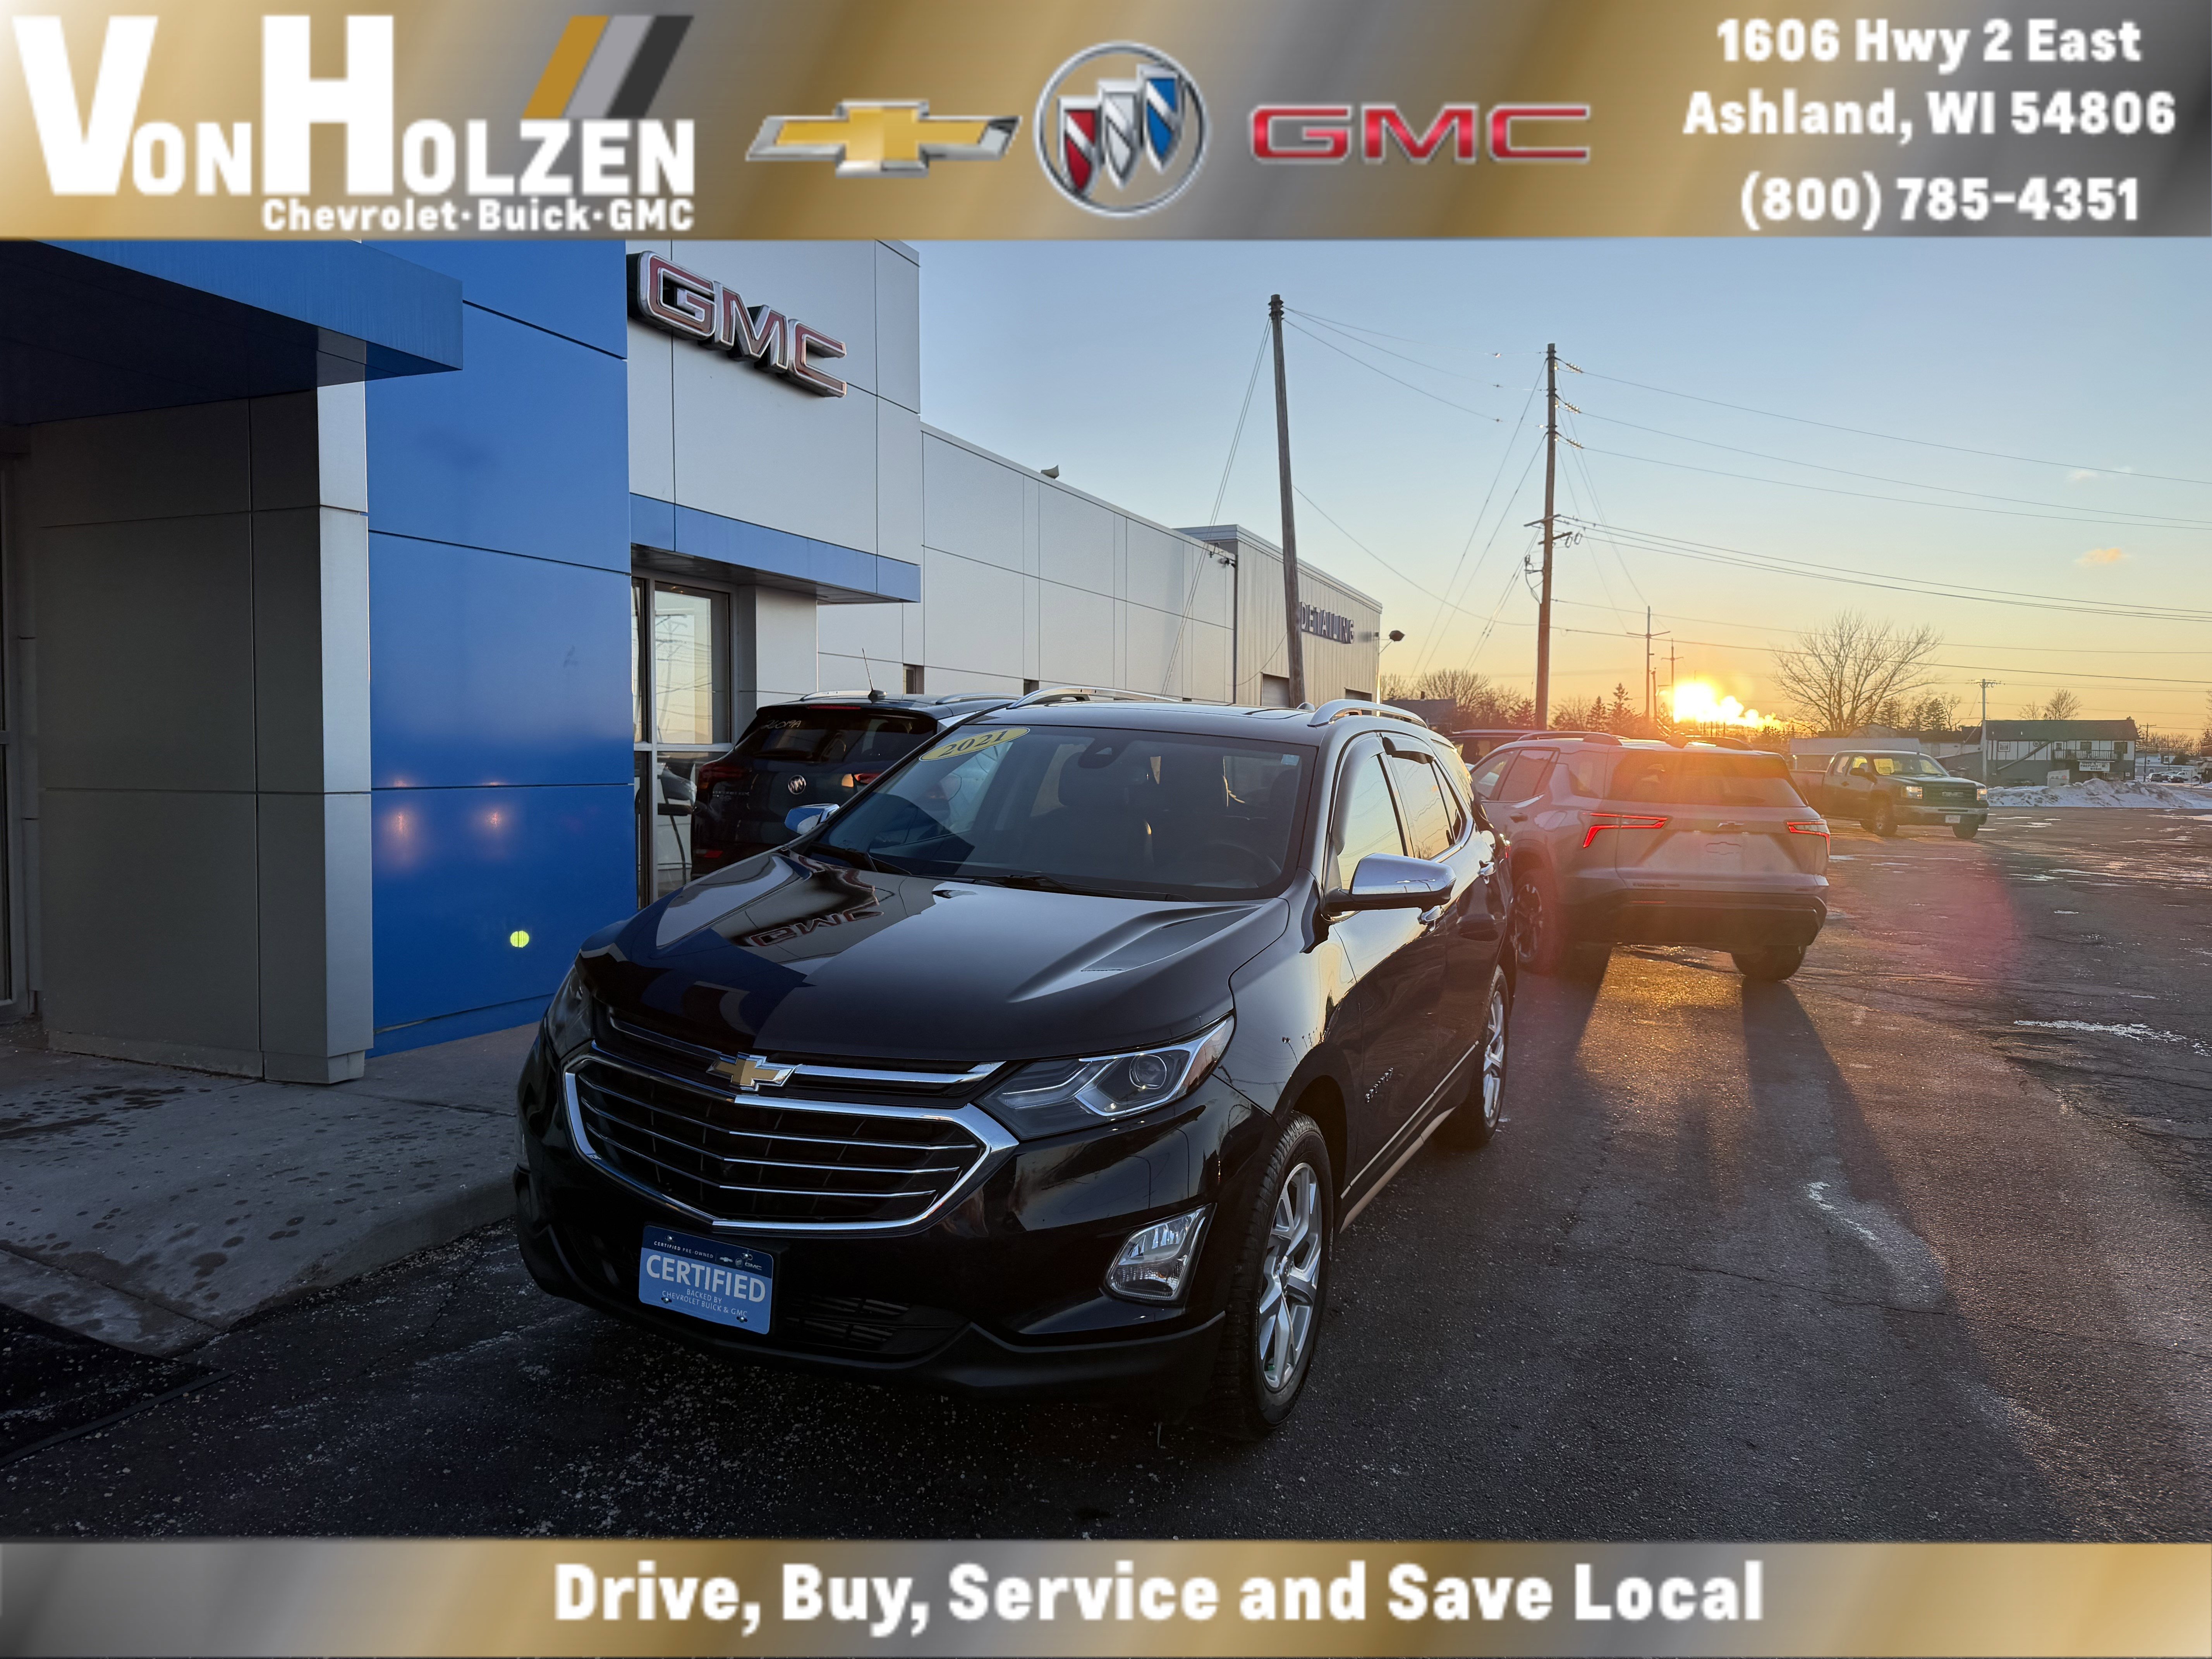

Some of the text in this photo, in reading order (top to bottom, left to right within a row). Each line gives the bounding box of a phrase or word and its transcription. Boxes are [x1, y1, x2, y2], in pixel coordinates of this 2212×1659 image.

[634, 250, 847, 398] GMC
[1300, 601, 1355, 644] DETAILING
[938, 730, 1008, 757] 2021
[654, 1241, 714, 1259] CERTIFIED PRE-OWNED
[646, 1254, 766, 1303] CERTIFIED
[744, 1262, 763, 1271] GMC
[662, 1290, 700, 1305] CHEVROLET
[701, 1301, 722, 1312] BUICK
[731, 1308, 748, 1317] GMC
[687, 1288, 712, 1301] BACKED
